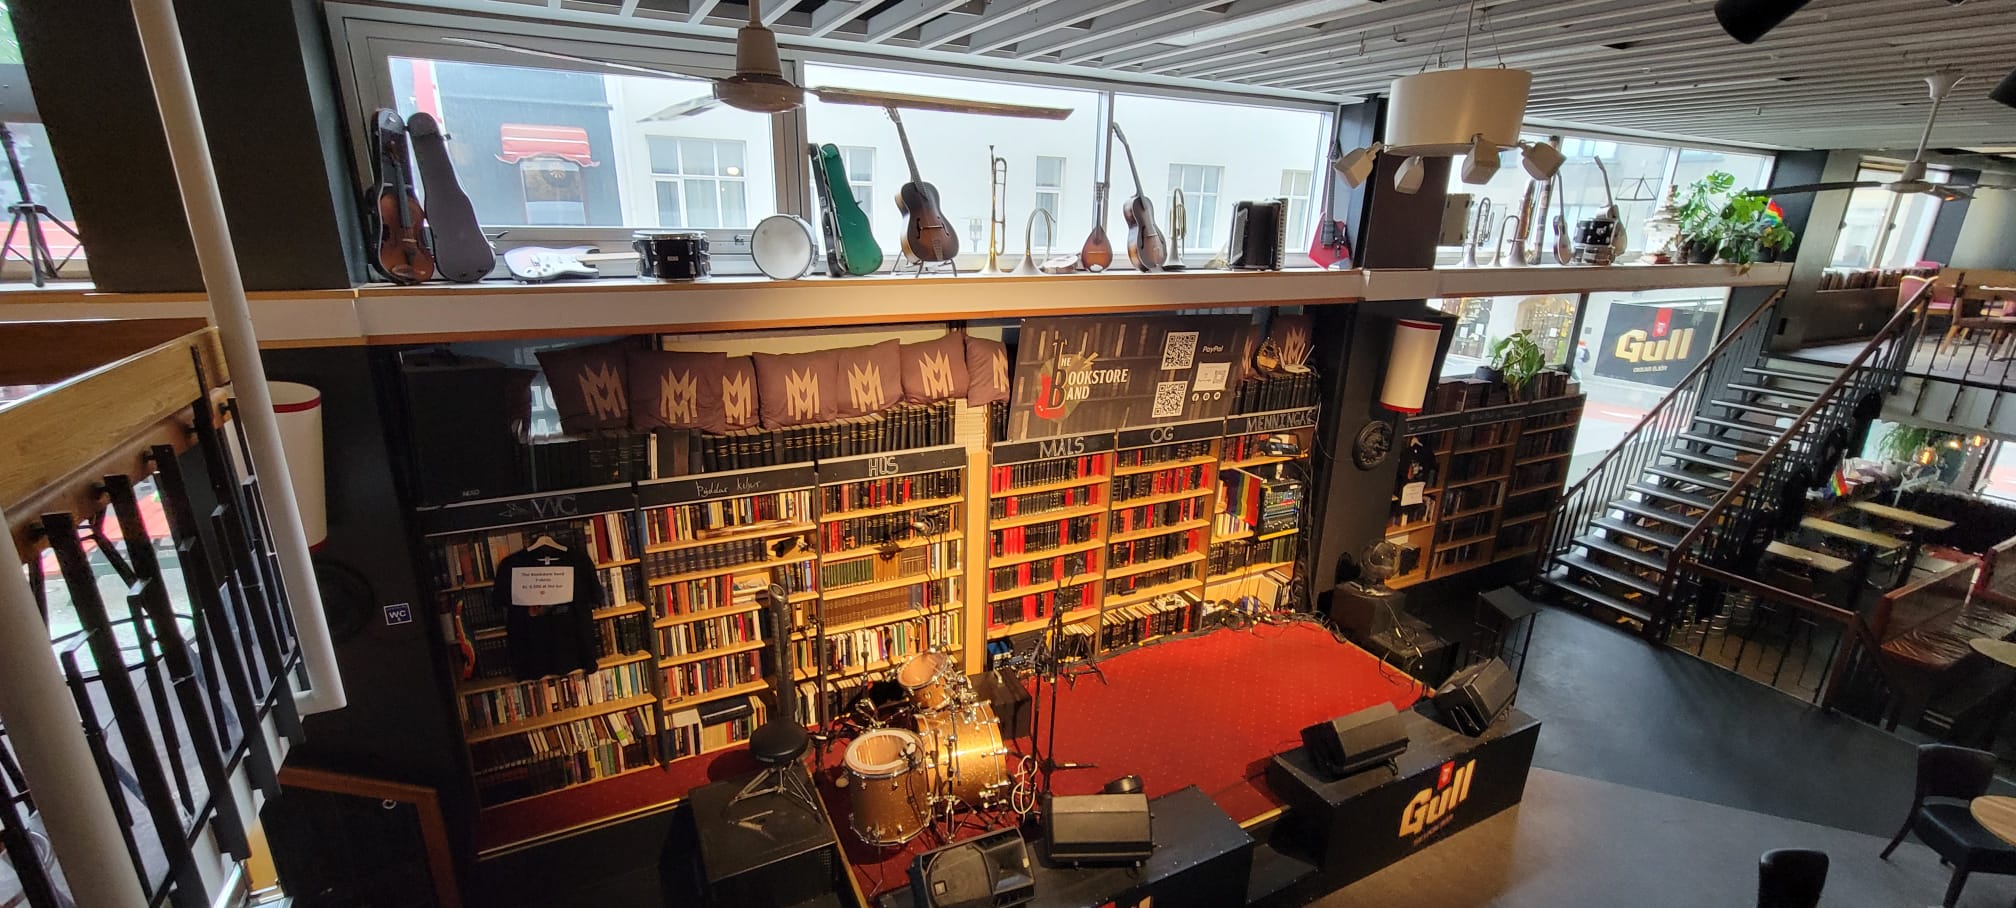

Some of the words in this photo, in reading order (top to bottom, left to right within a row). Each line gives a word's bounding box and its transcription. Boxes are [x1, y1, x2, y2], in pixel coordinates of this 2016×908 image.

[1615, 328, 1694, 363] Gull
[1150, 426, 1174, 443] OG
[389, 610, 407, 619] WC
[1399, 759, 1476, 837] Gull
